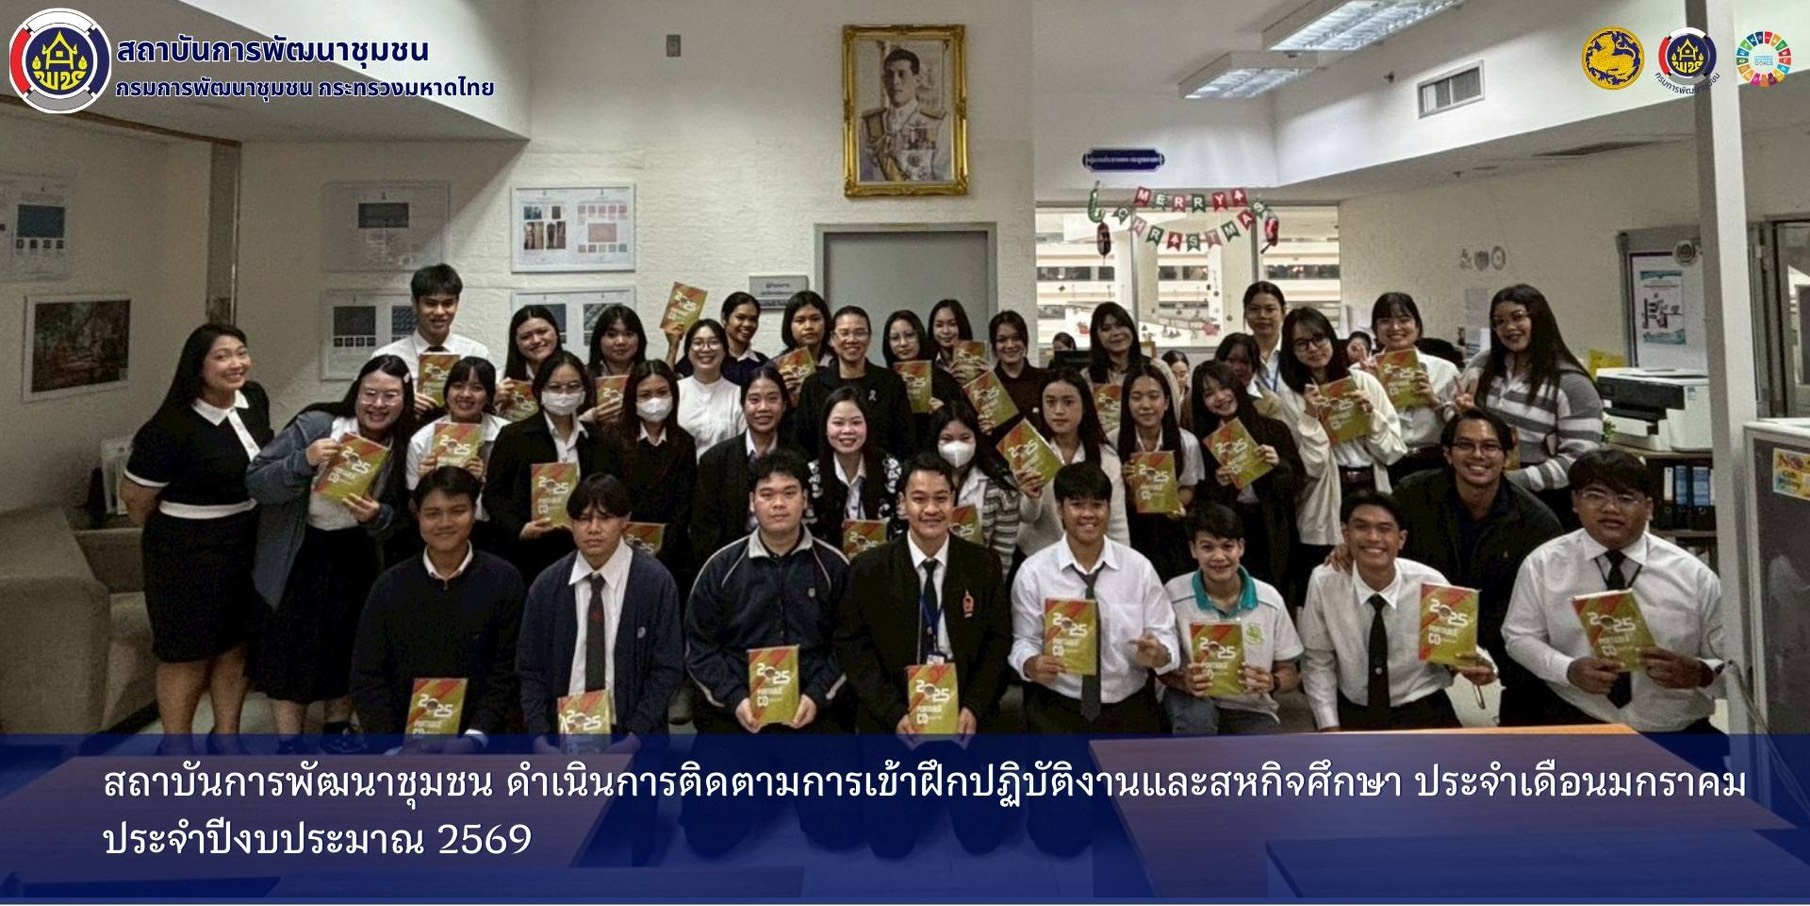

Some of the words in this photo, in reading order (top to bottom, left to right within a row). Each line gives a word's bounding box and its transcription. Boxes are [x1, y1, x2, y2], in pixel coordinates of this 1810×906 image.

[1135, 187, 1228, 210] MERRY
[1384, 363, 1414, 378] 2025
[439, 435, 471, 455] 2025
[1008, 439, 1039, 458] 2025
[1215, 438, 1248, 454] 2025
[341, 446, 371, 474] 2025
[1139, 464, 1169, 483] 2025
[538, 476, 569, 494] 2025
[1429, 598, 1468, 627] 2025
[1587, 612, 1635, 632] 2025
[1052, 612, 1087, 636] 2025
[1200, 637, 1236, 659] 2025
[756, 662, 790, 685] 2025
[916, 679, 950, 702] 2025
[418, 693, 453, 717] 2025
[566, 710, 602, 728] 2025
